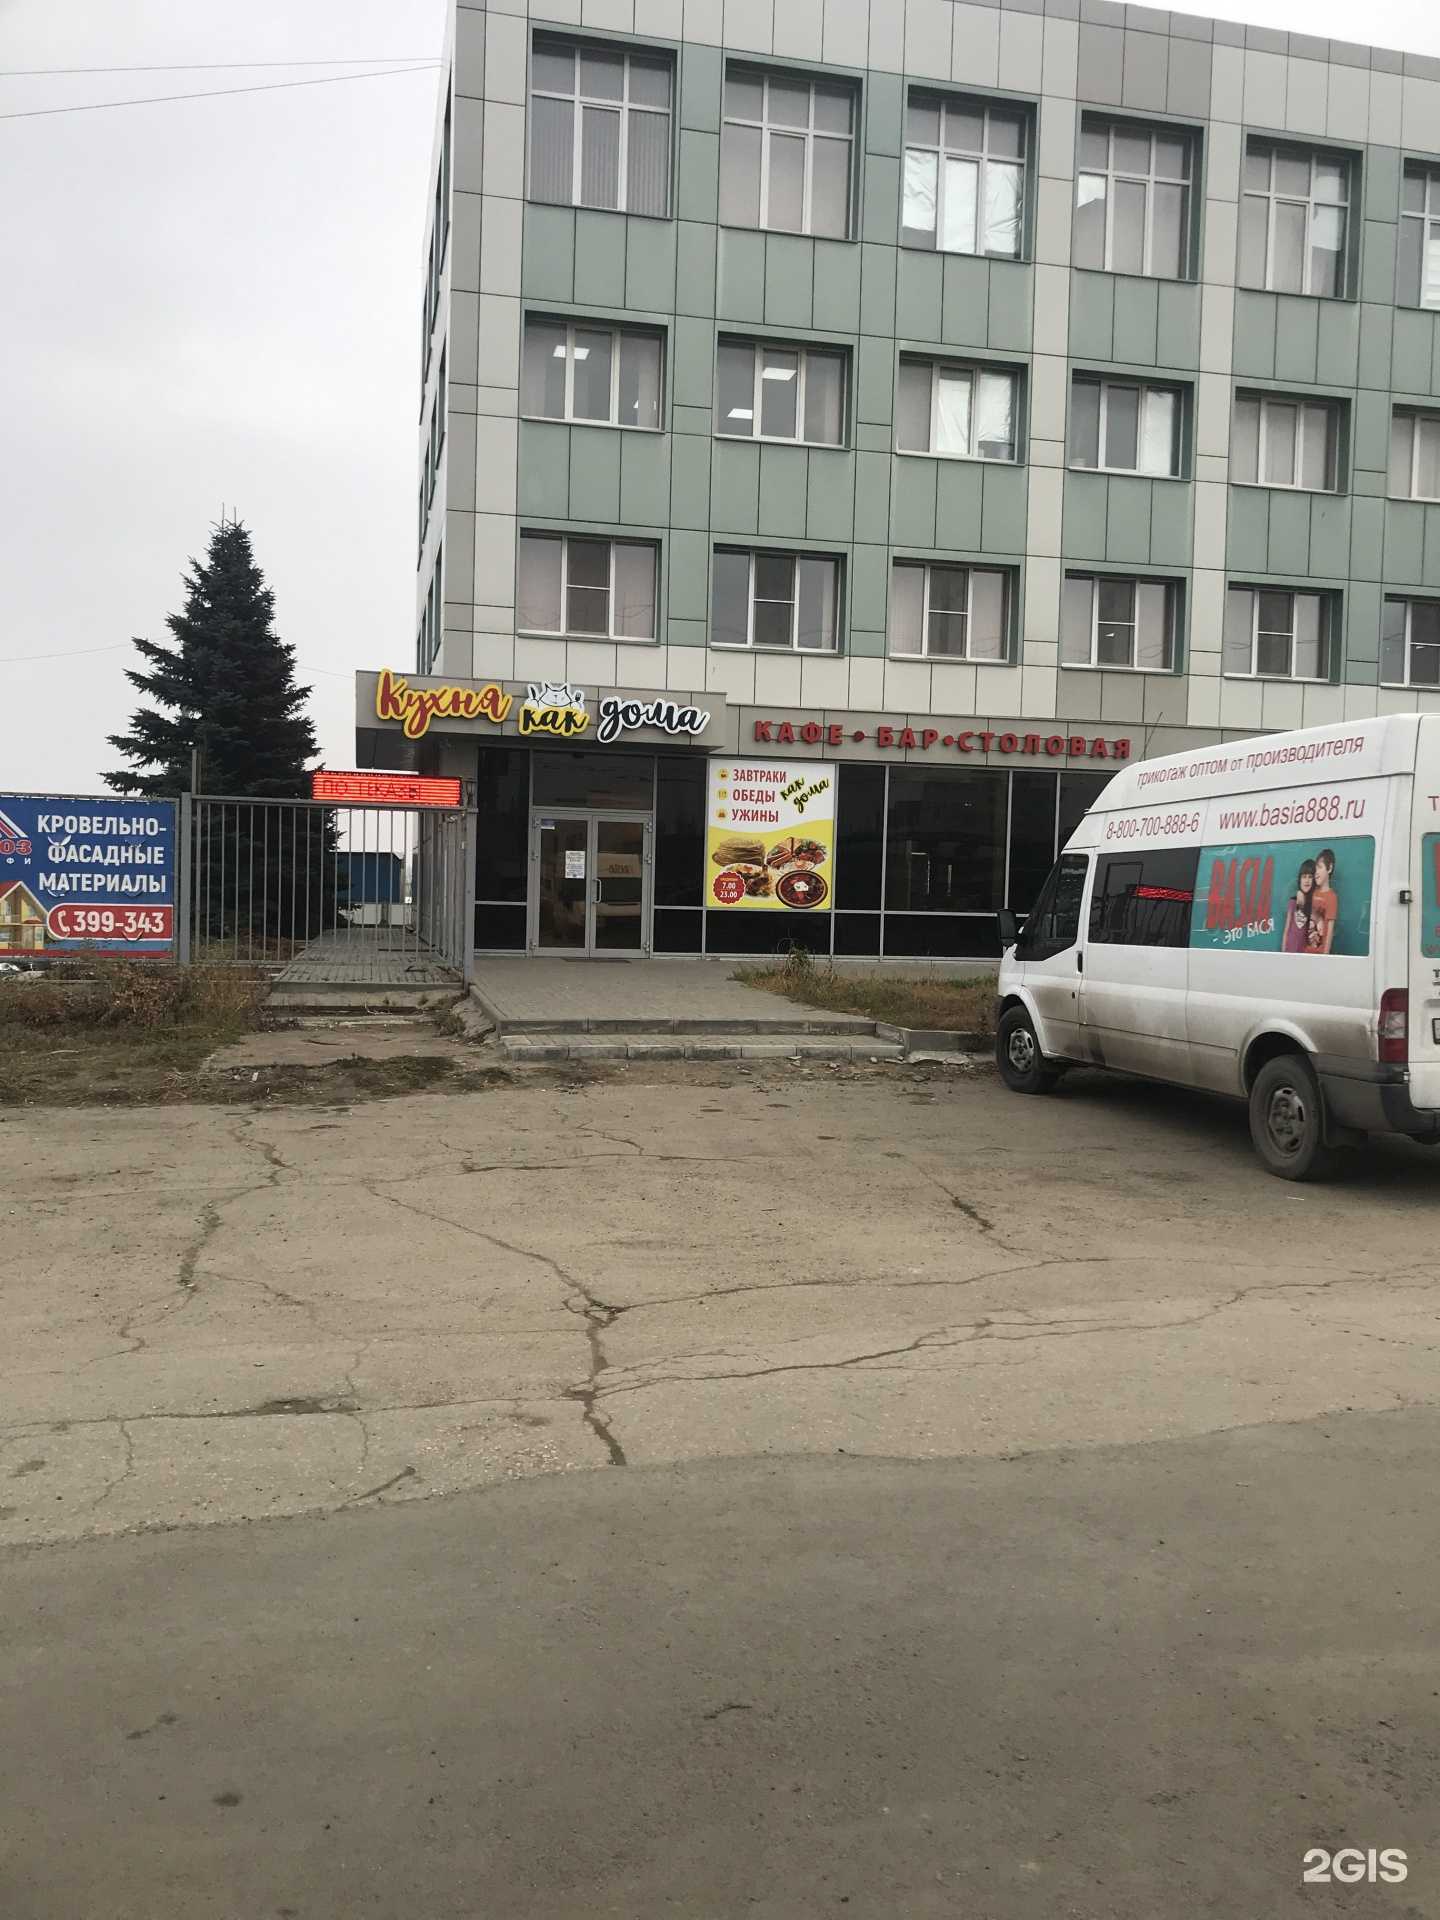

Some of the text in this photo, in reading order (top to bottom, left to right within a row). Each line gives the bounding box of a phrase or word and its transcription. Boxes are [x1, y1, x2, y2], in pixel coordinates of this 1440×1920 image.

[377, 669, 710, 743] Кухня как дома
[754, 720, 1131, 758] КАФЕ БАР СТОЛОВАЯ
[1136, 736, 1364, 788] трикотаж оптом от производителя
[733, 769, 786, 783] ЗАВТРАКИ
[732, 789, 775, 804] ОБЕДЫ
[780, 777, 805, 800] как
[793, 778, 829, 814] дома
[37, 815, 167, 835] КРОВЕЛЬНО-
[732, 809, 778, 822] УЖИНЫ
[1219, 796, 1365, 830] www.basia888.ru
[1106, 813, 1200, 840] 8-800-700-888-6
[48, 843, 164, 865] ФАСАДНЫЕ
[39, 873, 166, 893] МАТЕРИАЛЫ
[1206, 856, 1274, 929] BASIA
[73, 910, 165, 934] 399-343
